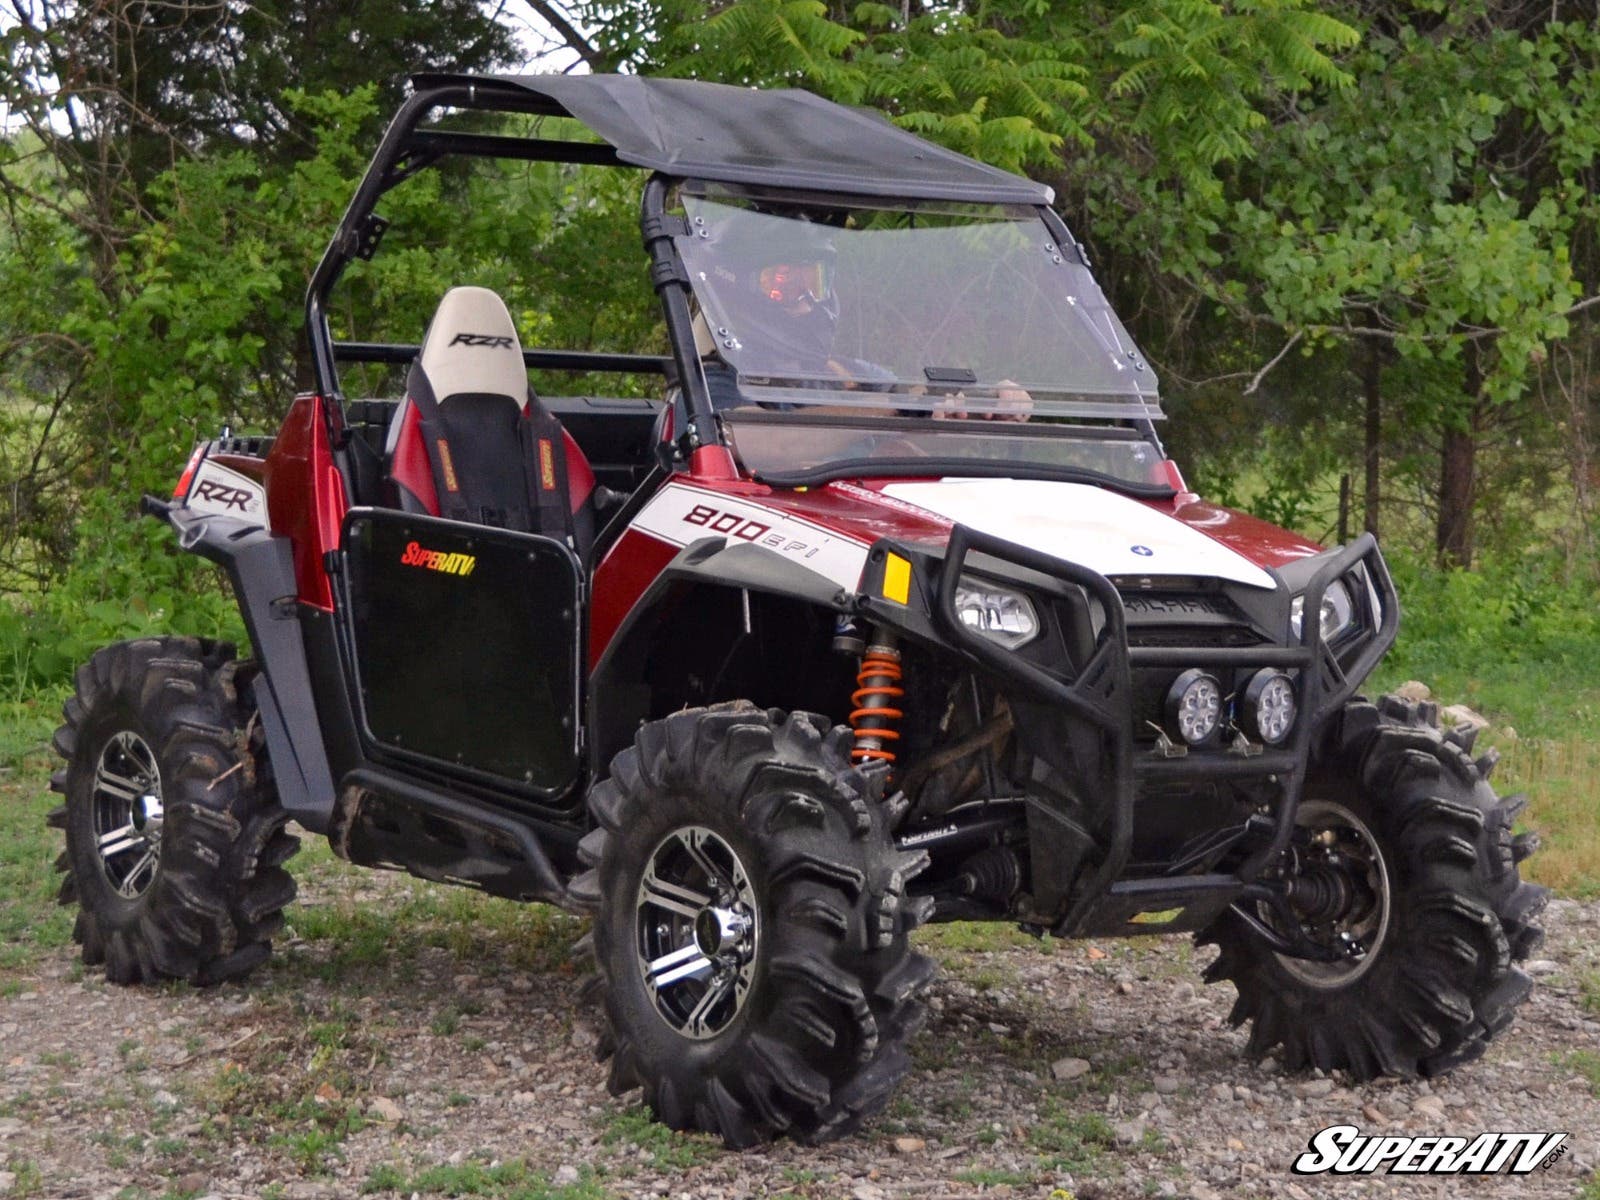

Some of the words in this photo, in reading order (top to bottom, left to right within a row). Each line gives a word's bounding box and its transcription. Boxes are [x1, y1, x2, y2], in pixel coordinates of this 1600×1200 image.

[448, 333, 515, 349] RZR
[192, 479, 253, 512] RZR
[682, 504, 772, 542] 800
